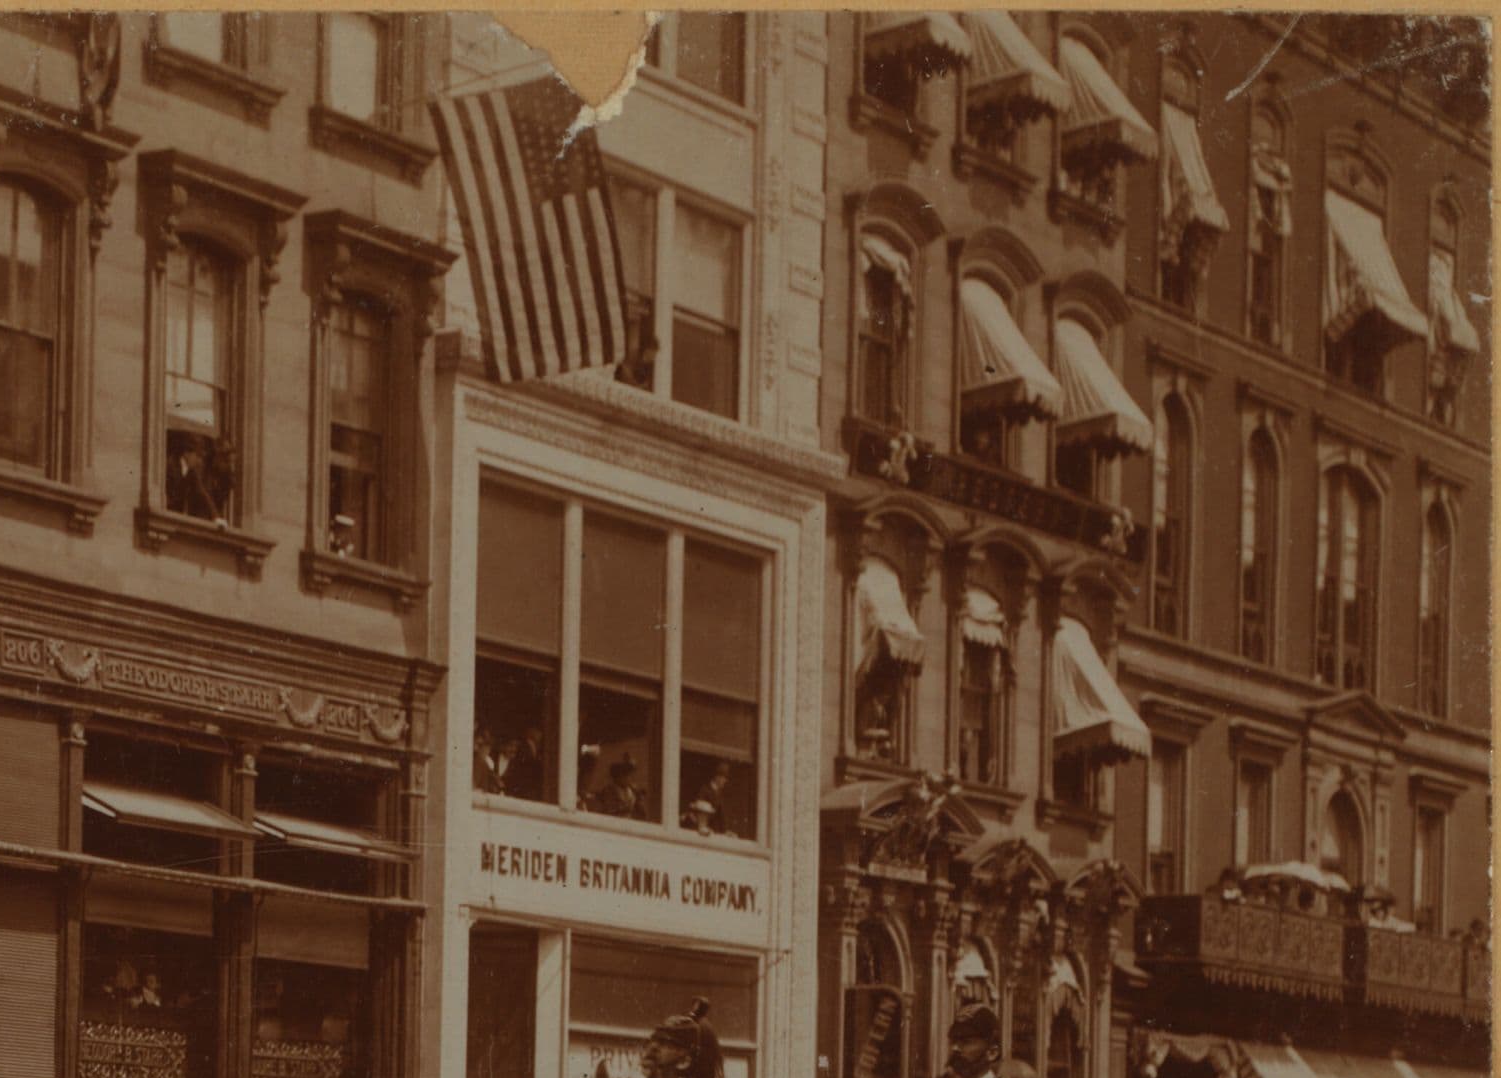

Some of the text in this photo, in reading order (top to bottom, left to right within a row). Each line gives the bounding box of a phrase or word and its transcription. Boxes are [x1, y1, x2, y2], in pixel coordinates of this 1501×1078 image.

[4, 638, 41, 665] 206
[107, 659, 201, 696] THEODORE
[480, 840, 568, 883] MERIDEN
[579, 856, 671, 901] BRITANNIA
